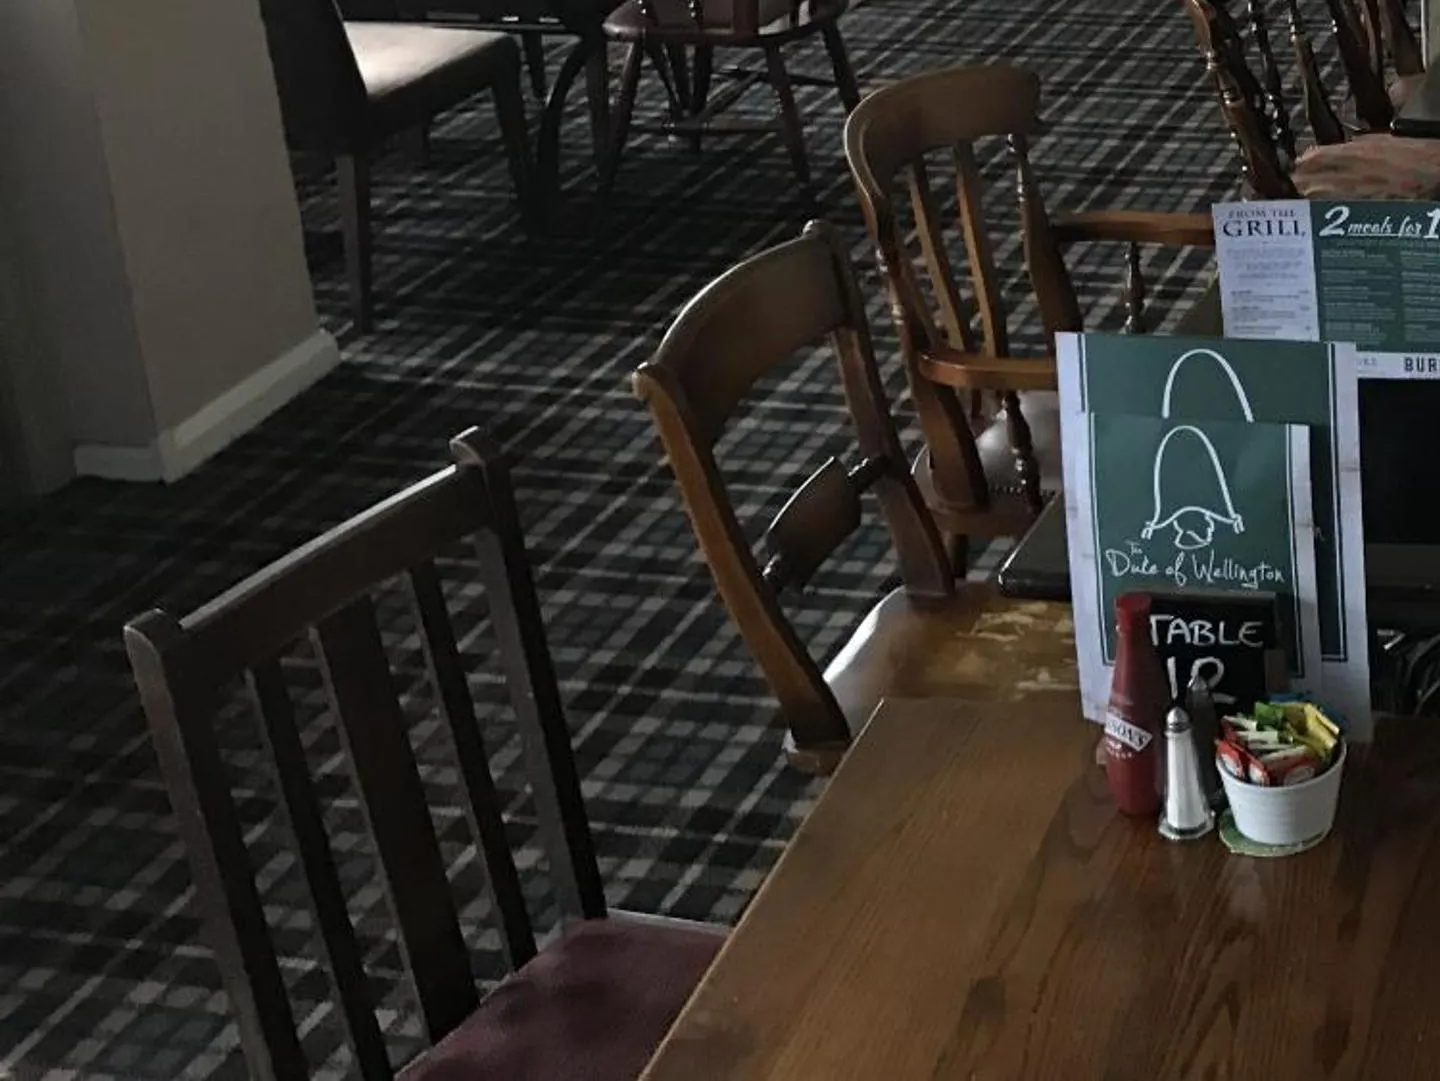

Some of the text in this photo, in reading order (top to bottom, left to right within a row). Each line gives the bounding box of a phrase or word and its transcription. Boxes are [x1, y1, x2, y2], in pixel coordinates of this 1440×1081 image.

[1223, 218, 1307, 238] GRILL
[1269, 208, 1297, 218] THE
[1318, 205, 1350, 237] 2
[1346, 214, 1393, 235] meals
[1397, 215, 1423, 238] for
[1104, 547, 1286, 589] Duke of Wellington
[1150, 614, 1265, 647] TABLE
